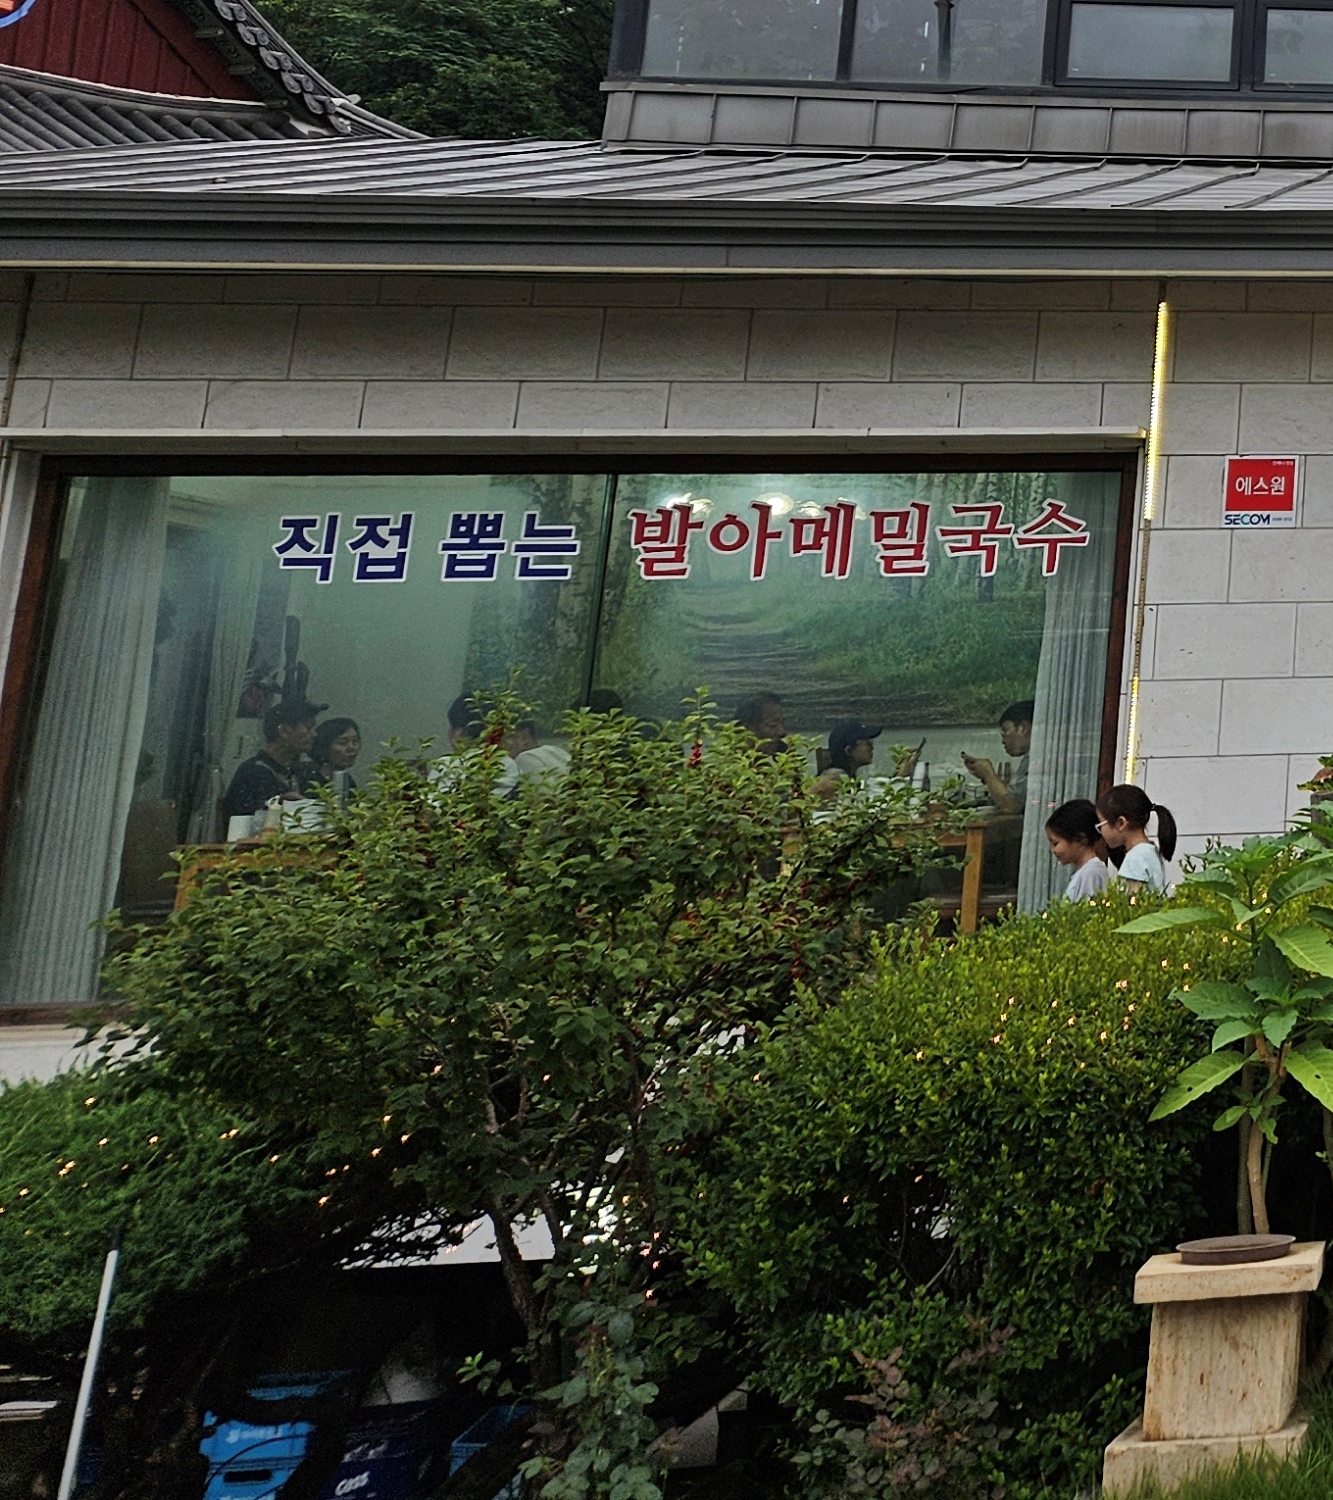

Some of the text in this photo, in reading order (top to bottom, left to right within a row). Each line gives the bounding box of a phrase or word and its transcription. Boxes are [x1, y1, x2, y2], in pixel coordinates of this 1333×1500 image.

[1235, 476, 1285, 495] 에스원
[1224, 514, 1271, 525] SECOM
[272, 498, 1090, 584] 직접 뽑는 발아메밀국수
